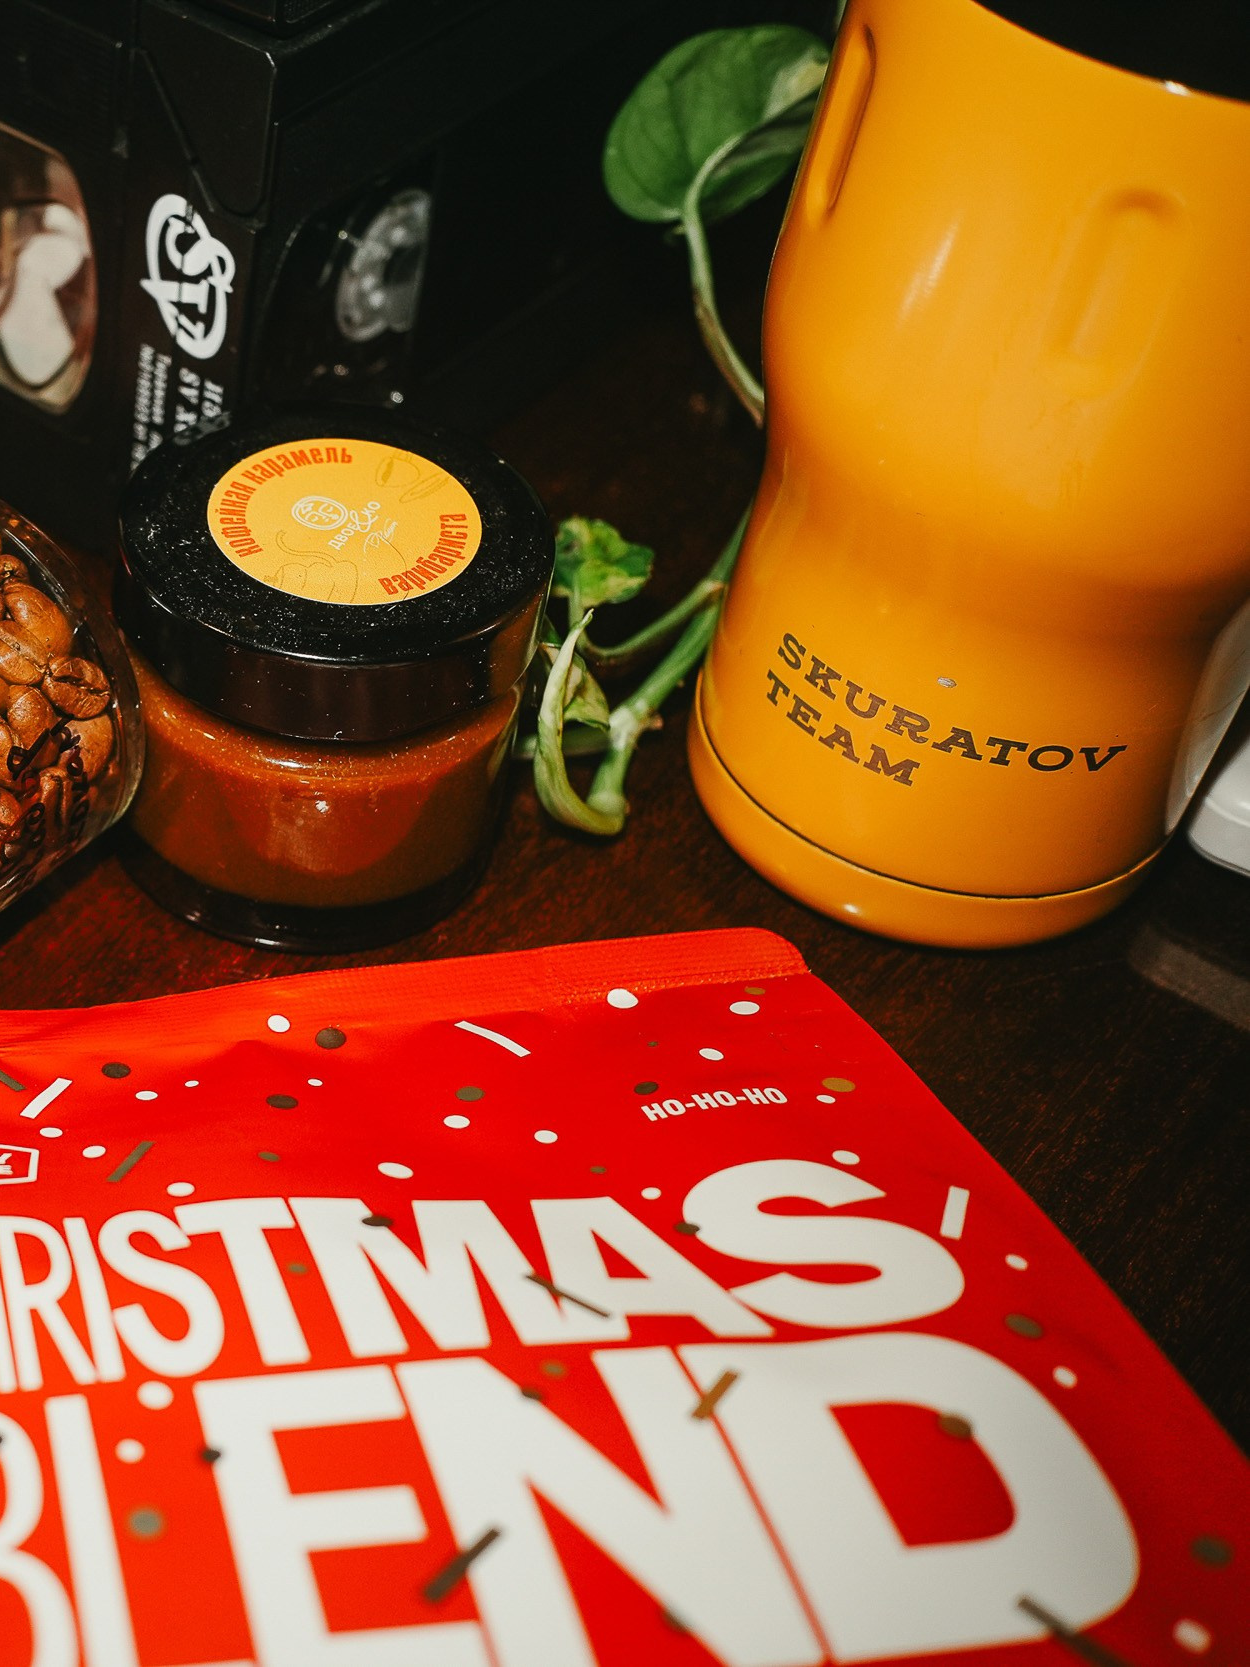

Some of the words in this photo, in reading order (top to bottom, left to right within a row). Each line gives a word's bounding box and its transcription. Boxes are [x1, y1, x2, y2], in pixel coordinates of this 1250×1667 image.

[766, 669, 921, 787] TEAM
[776, 632, 1129, 772] SKURATOV
[640, 1086, 789, 1122] HO-HO-HO
